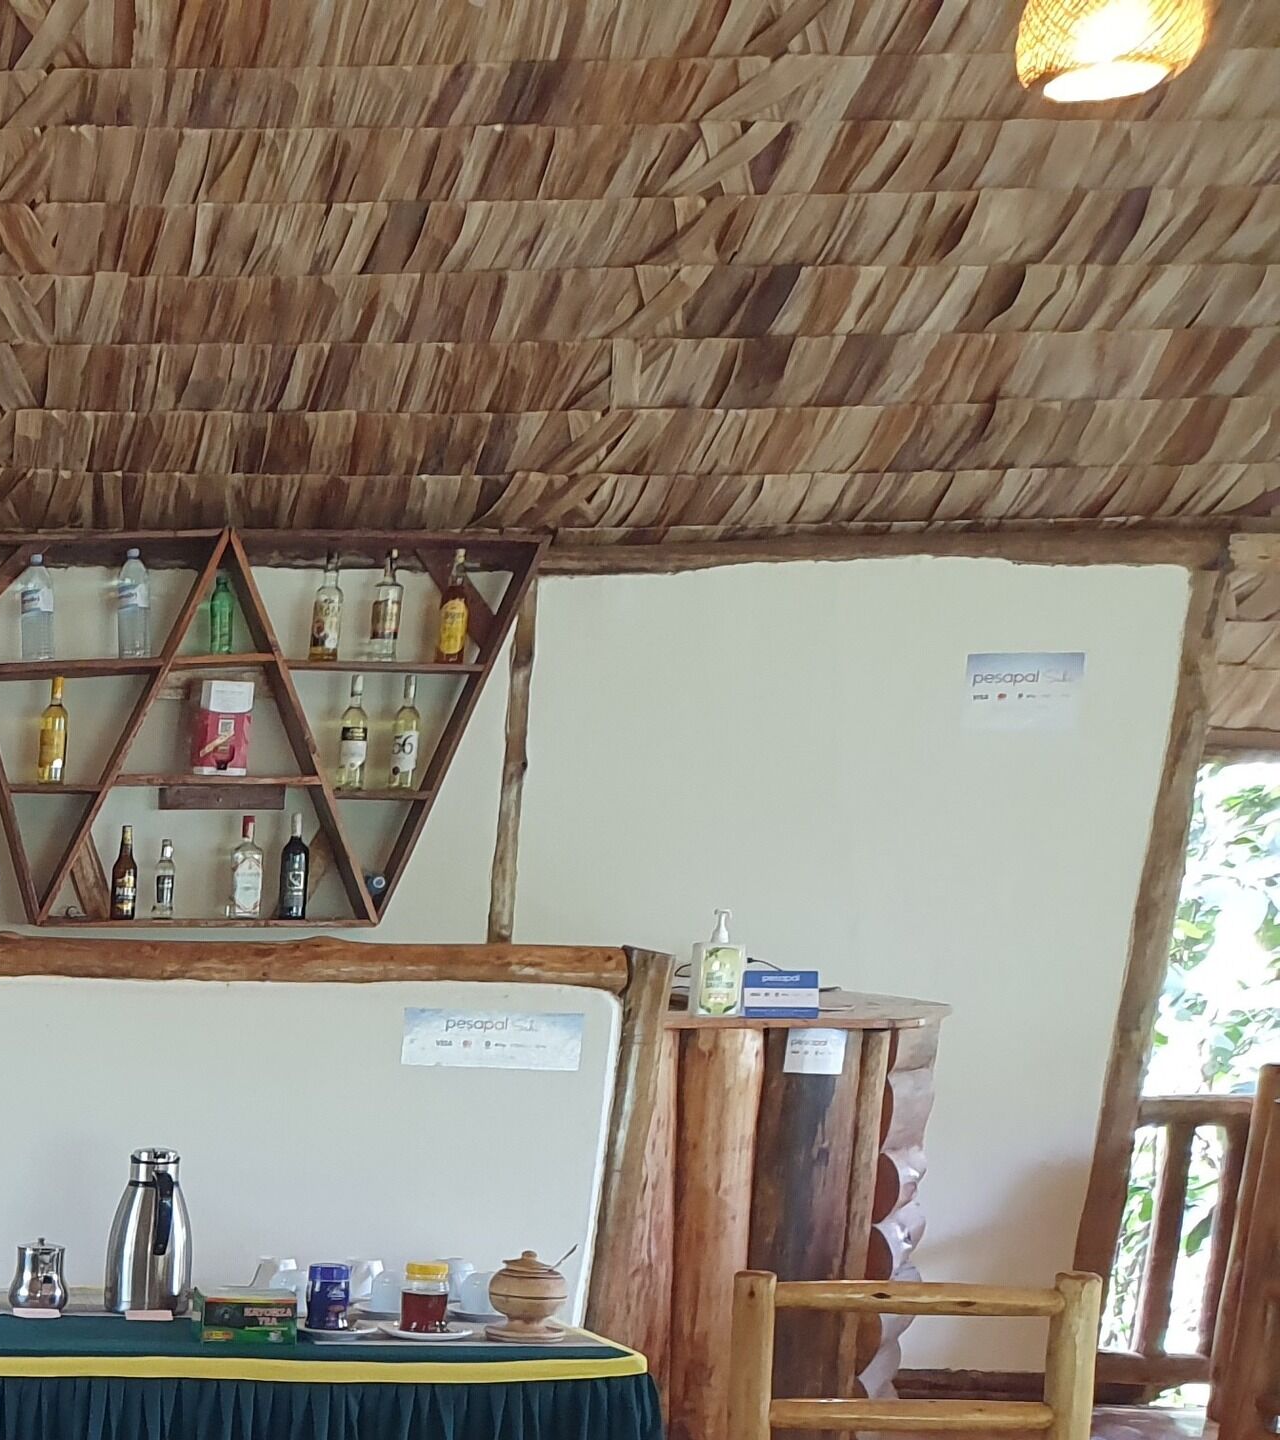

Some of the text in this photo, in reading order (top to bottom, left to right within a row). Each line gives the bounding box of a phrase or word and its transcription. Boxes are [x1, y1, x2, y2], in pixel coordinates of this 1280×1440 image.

[972, 669, 1040, 687] pesapal
[391, 734, 415, 755] 56
[445, 1017, 508, 1032] pesapal
